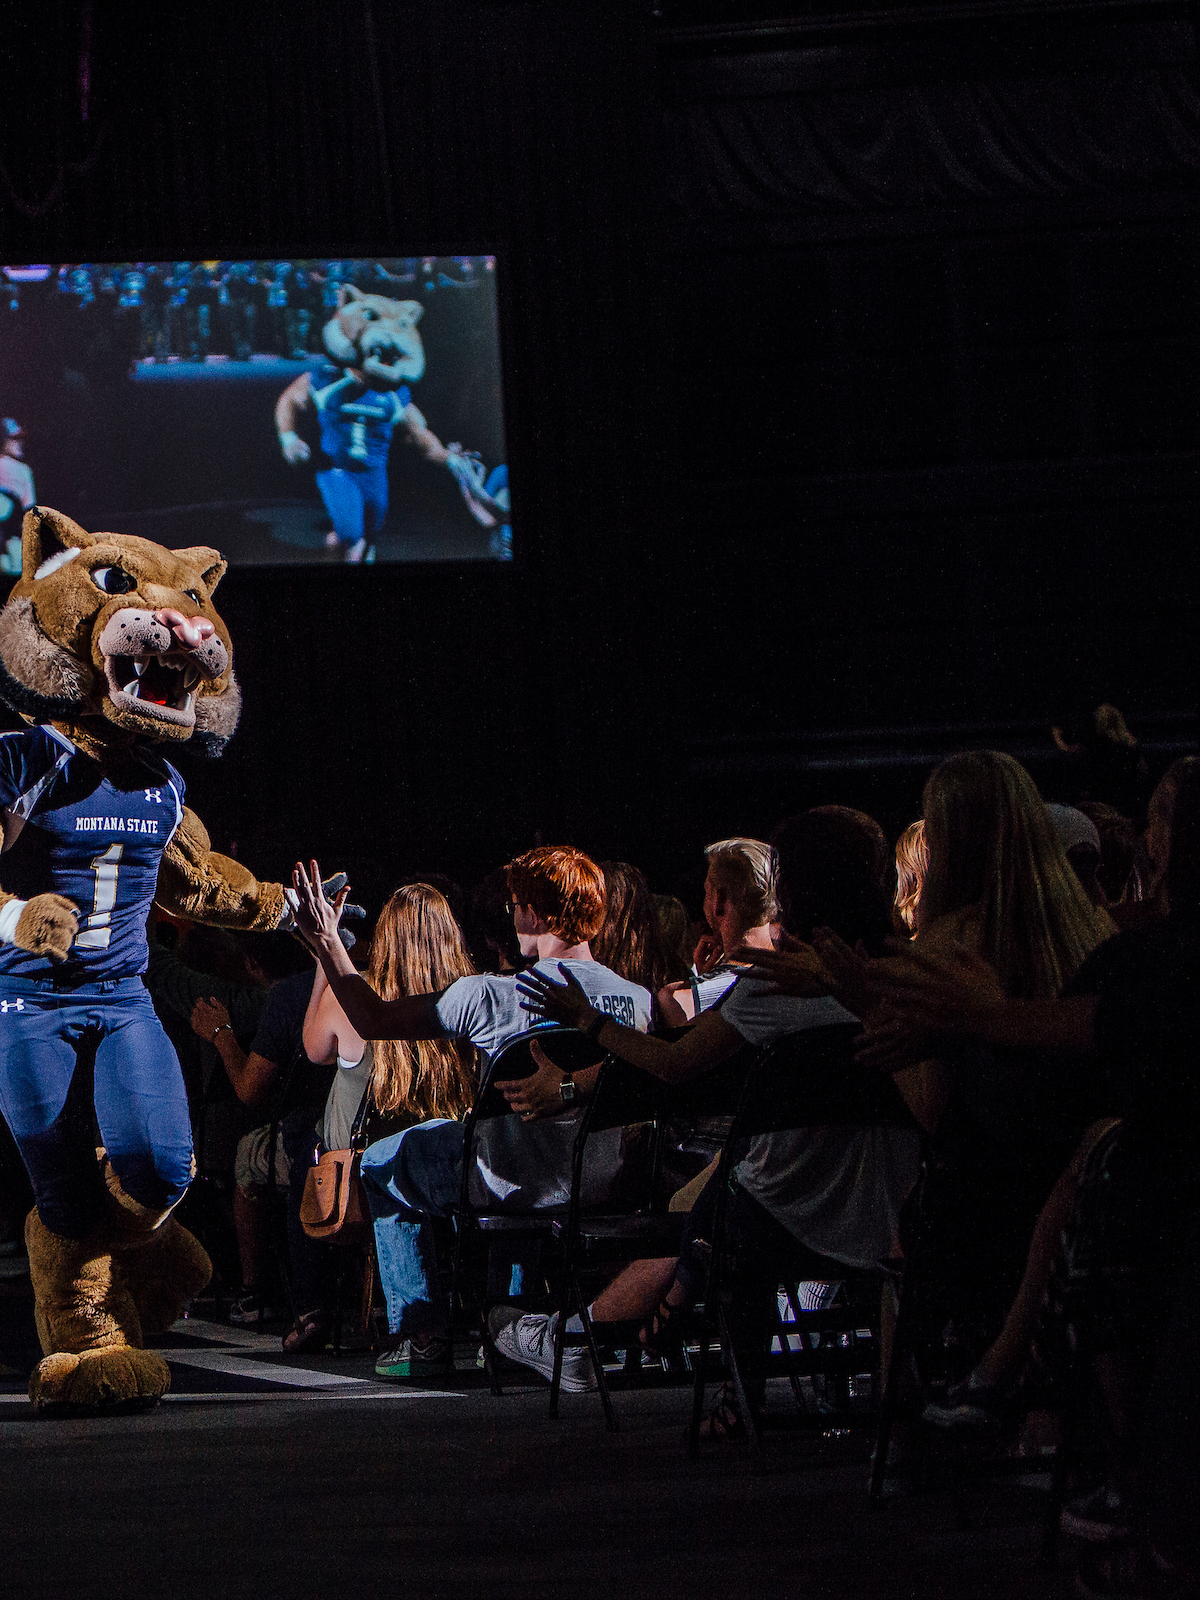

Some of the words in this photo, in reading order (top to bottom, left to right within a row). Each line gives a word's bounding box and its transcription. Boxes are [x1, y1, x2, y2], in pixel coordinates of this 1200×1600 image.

[75, 816, 126, 832] MONTANA
[126, 818, 159, 834] STATE
[75, 843, 124, 950] 1
